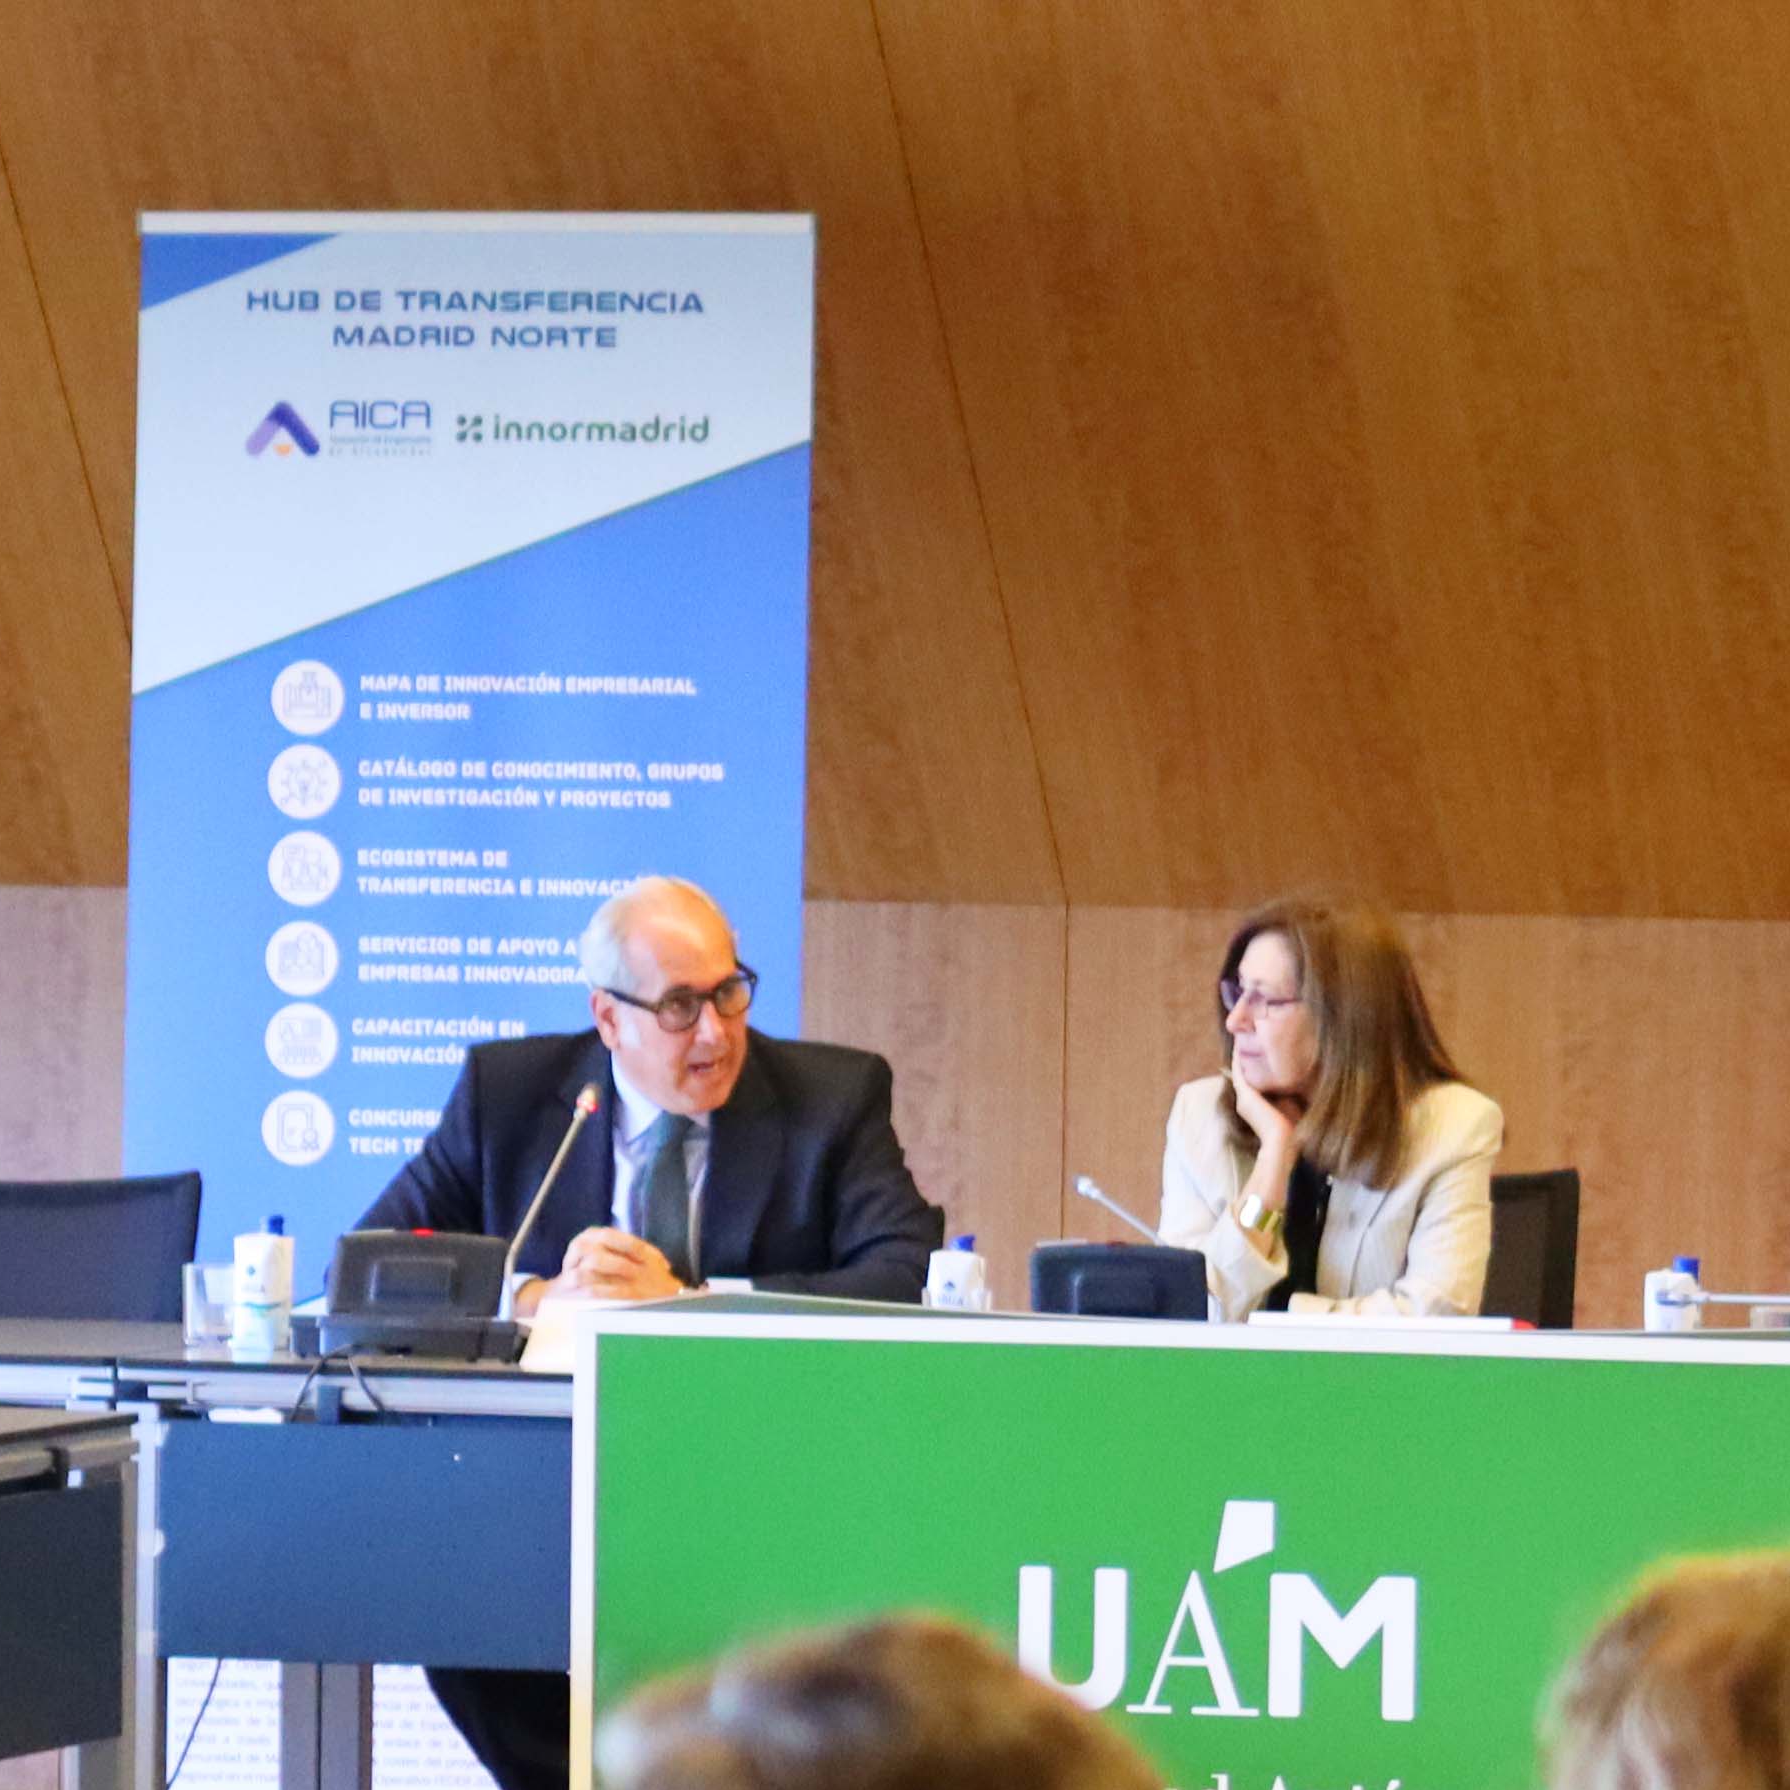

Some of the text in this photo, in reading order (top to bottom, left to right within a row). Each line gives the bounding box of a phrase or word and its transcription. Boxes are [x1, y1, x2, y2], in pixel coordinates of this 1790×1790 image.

[246, 290, 705, 314] HUB DE TRANSFERENCIA
[332, 325, 618, 348] MADRID NORTE
[329, 400, 432, 430] AICA
[494, 413, 710, 443] innormadrid
[360, 672, 696, 695] MAPA DE INNOVACIÓN EMPRESARIAL
[359, 704, 471, 720] E INVERSOR
[358, 757, 724, 782] CATÁLOGO DE CONOCIMIENTO, GRUPOS
[358, 785, 672, 808] DE INVESTIGACIÓN Y PROYECTOS
[358, 849, 509, 867] ECOSISTEMA DE
[358, 877, 513, 895] TRANSFERENCIA
[520, 878, 533, 896] E
[358, 937, 578, 956] SERVICIOS DE APOYO A
[358, 965, 588, 984] EMPRESAS INNOVADORA
[351, 1016, 525, 1037] CAPACITACIÓN EN
[349, 1109, 442, 1128] CONCURS
[349, 1137, 398, 1154] TECH
